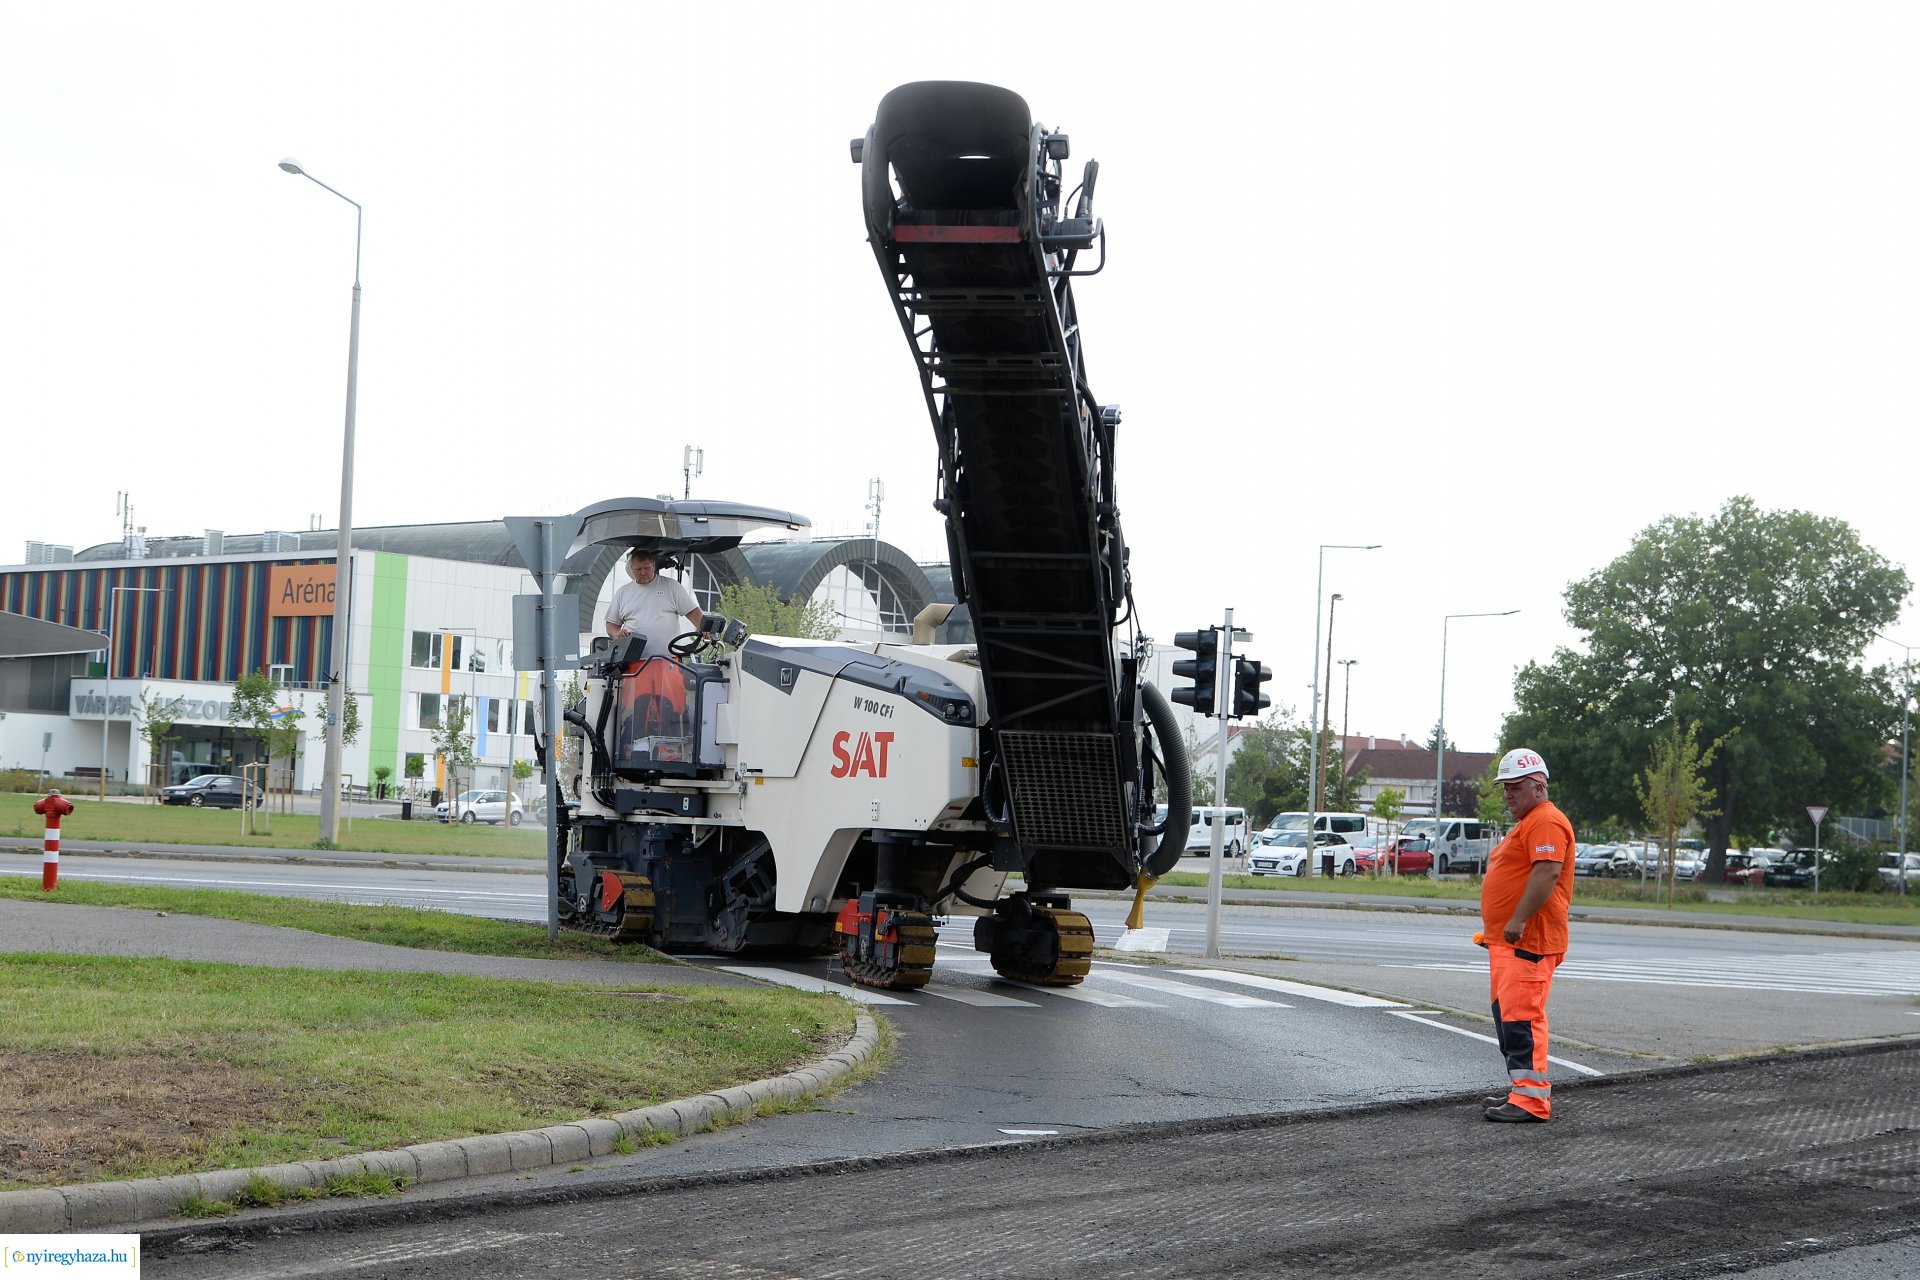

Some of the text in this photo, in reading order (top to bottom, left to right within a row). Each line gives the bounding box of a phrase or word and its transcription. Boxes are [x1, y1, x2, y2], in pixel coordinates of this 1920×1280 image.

[281, 577, 336, 604] Aréna
[154, 697, 256, 722] USZOD
[853, 696, 863, 709] W
[864, 699, 879, 714] 100
[830, 730, 895, 778] SAT
